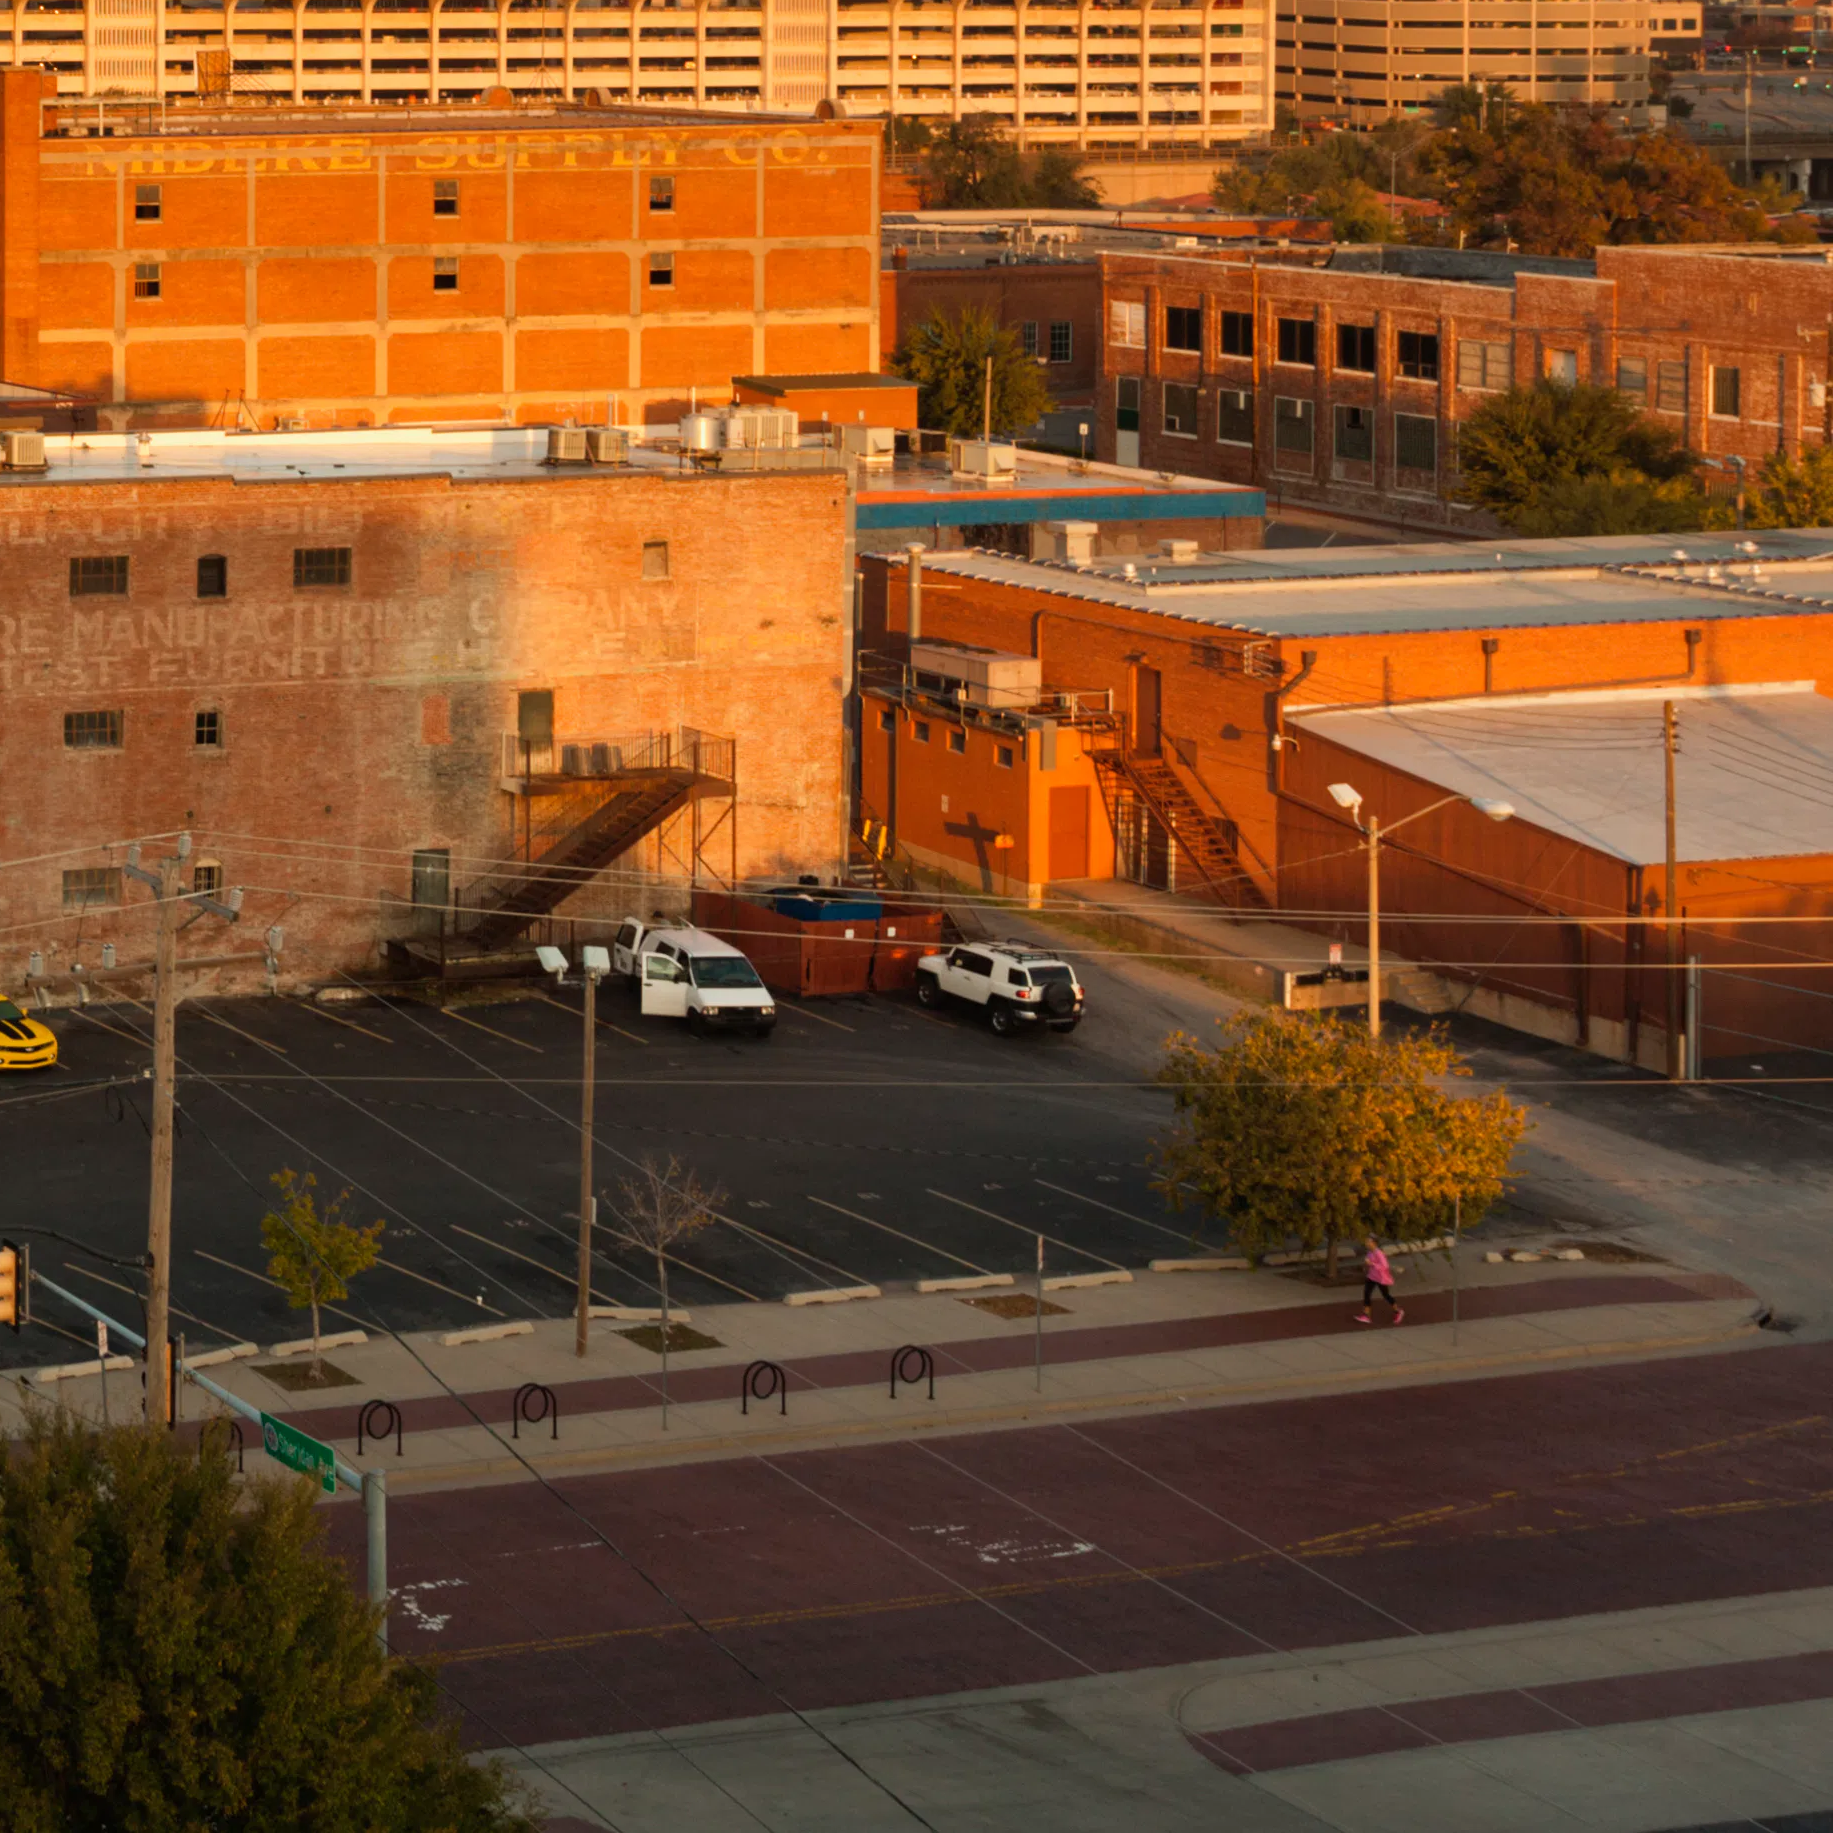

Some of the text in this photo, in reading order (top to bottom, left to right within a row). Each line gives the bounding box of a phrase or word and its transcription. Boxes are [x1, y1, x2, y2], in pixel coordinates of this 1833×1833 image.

[85, 129, 829, 176] MIDEKE SUPPLY CO.
[72, 598, 445, 650] MANUFACTURING
[469, 586, 682, 636] CANY
